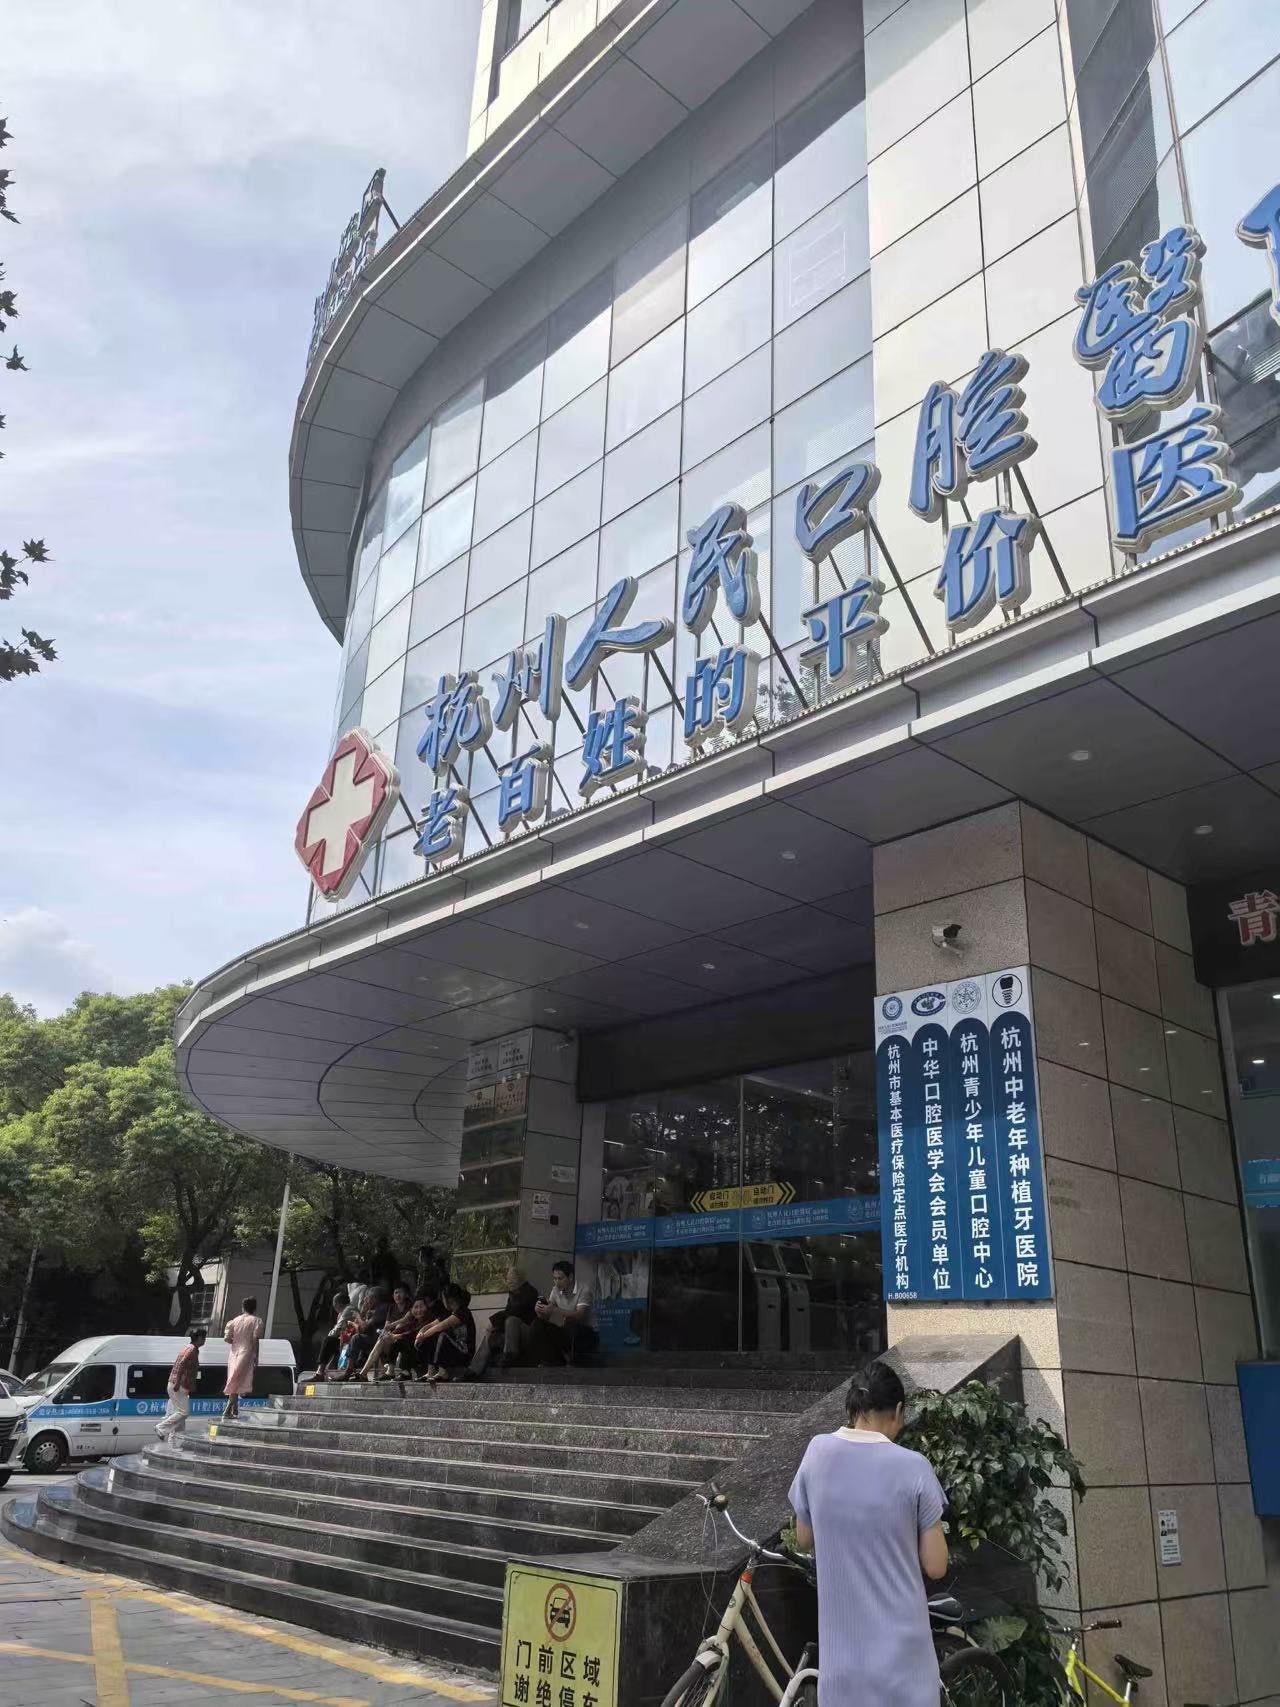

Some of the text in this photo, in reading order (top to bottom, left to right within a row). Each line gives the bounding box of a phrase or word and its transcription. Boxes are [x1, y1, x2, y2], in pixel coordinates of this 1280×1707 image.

[887, 1044, 909, 1290] 杭州市基本医疗保险定点医疗机构
[922, 1038, 950, 1290] 中华口腔医学会会员单位
[960, 1032, 993, 1289] 杭州青少年儿童口腔中心
[1001, 1026, 1039, 1287] 杭州中老年种植牙医院
[516, 1639, 601, 1687] 门前区域
